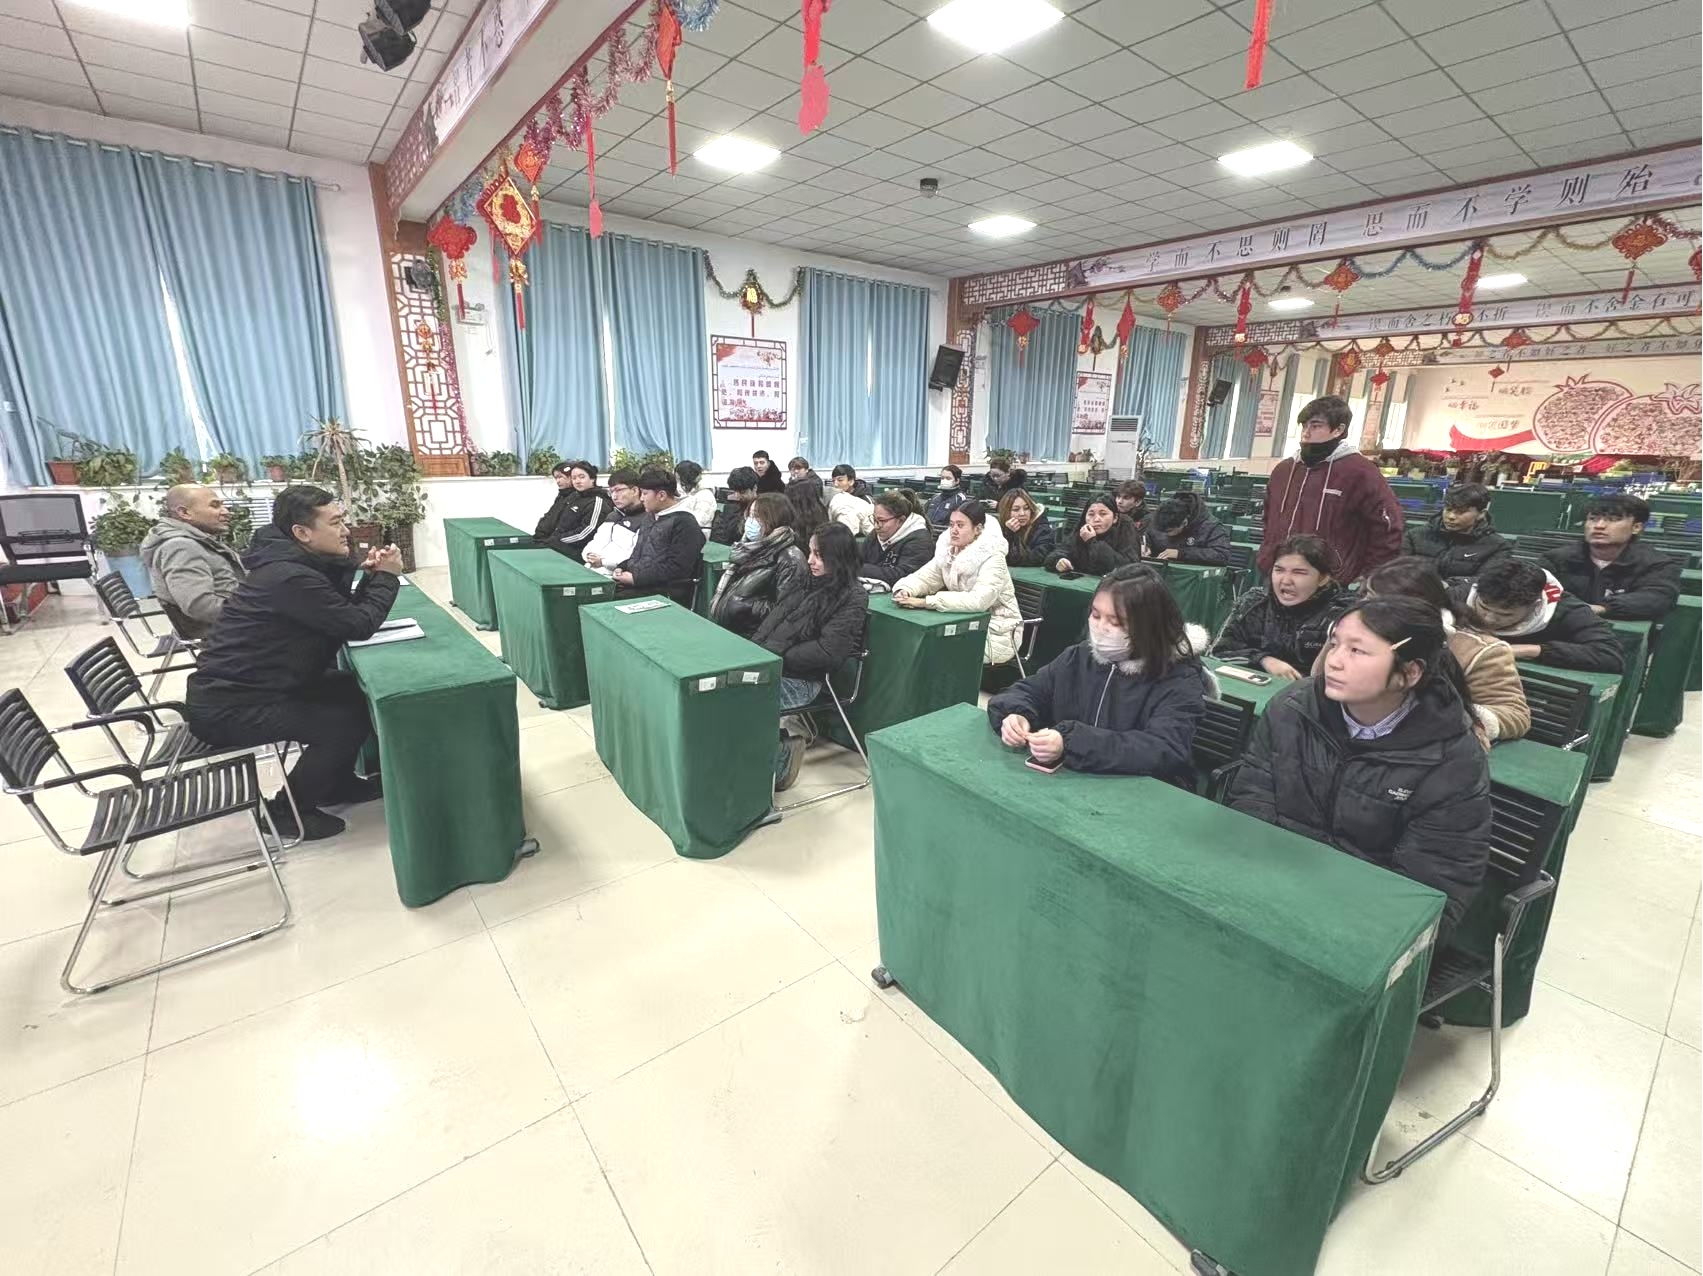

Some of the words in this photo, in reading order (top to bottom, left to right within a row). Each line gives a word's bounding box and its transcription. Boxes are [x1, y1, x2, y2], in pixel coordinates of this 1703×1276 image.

[1145, 221, 1328, 272] 学而不思则罔
[1362, 164, 1653, 237] 思而不学则殆
